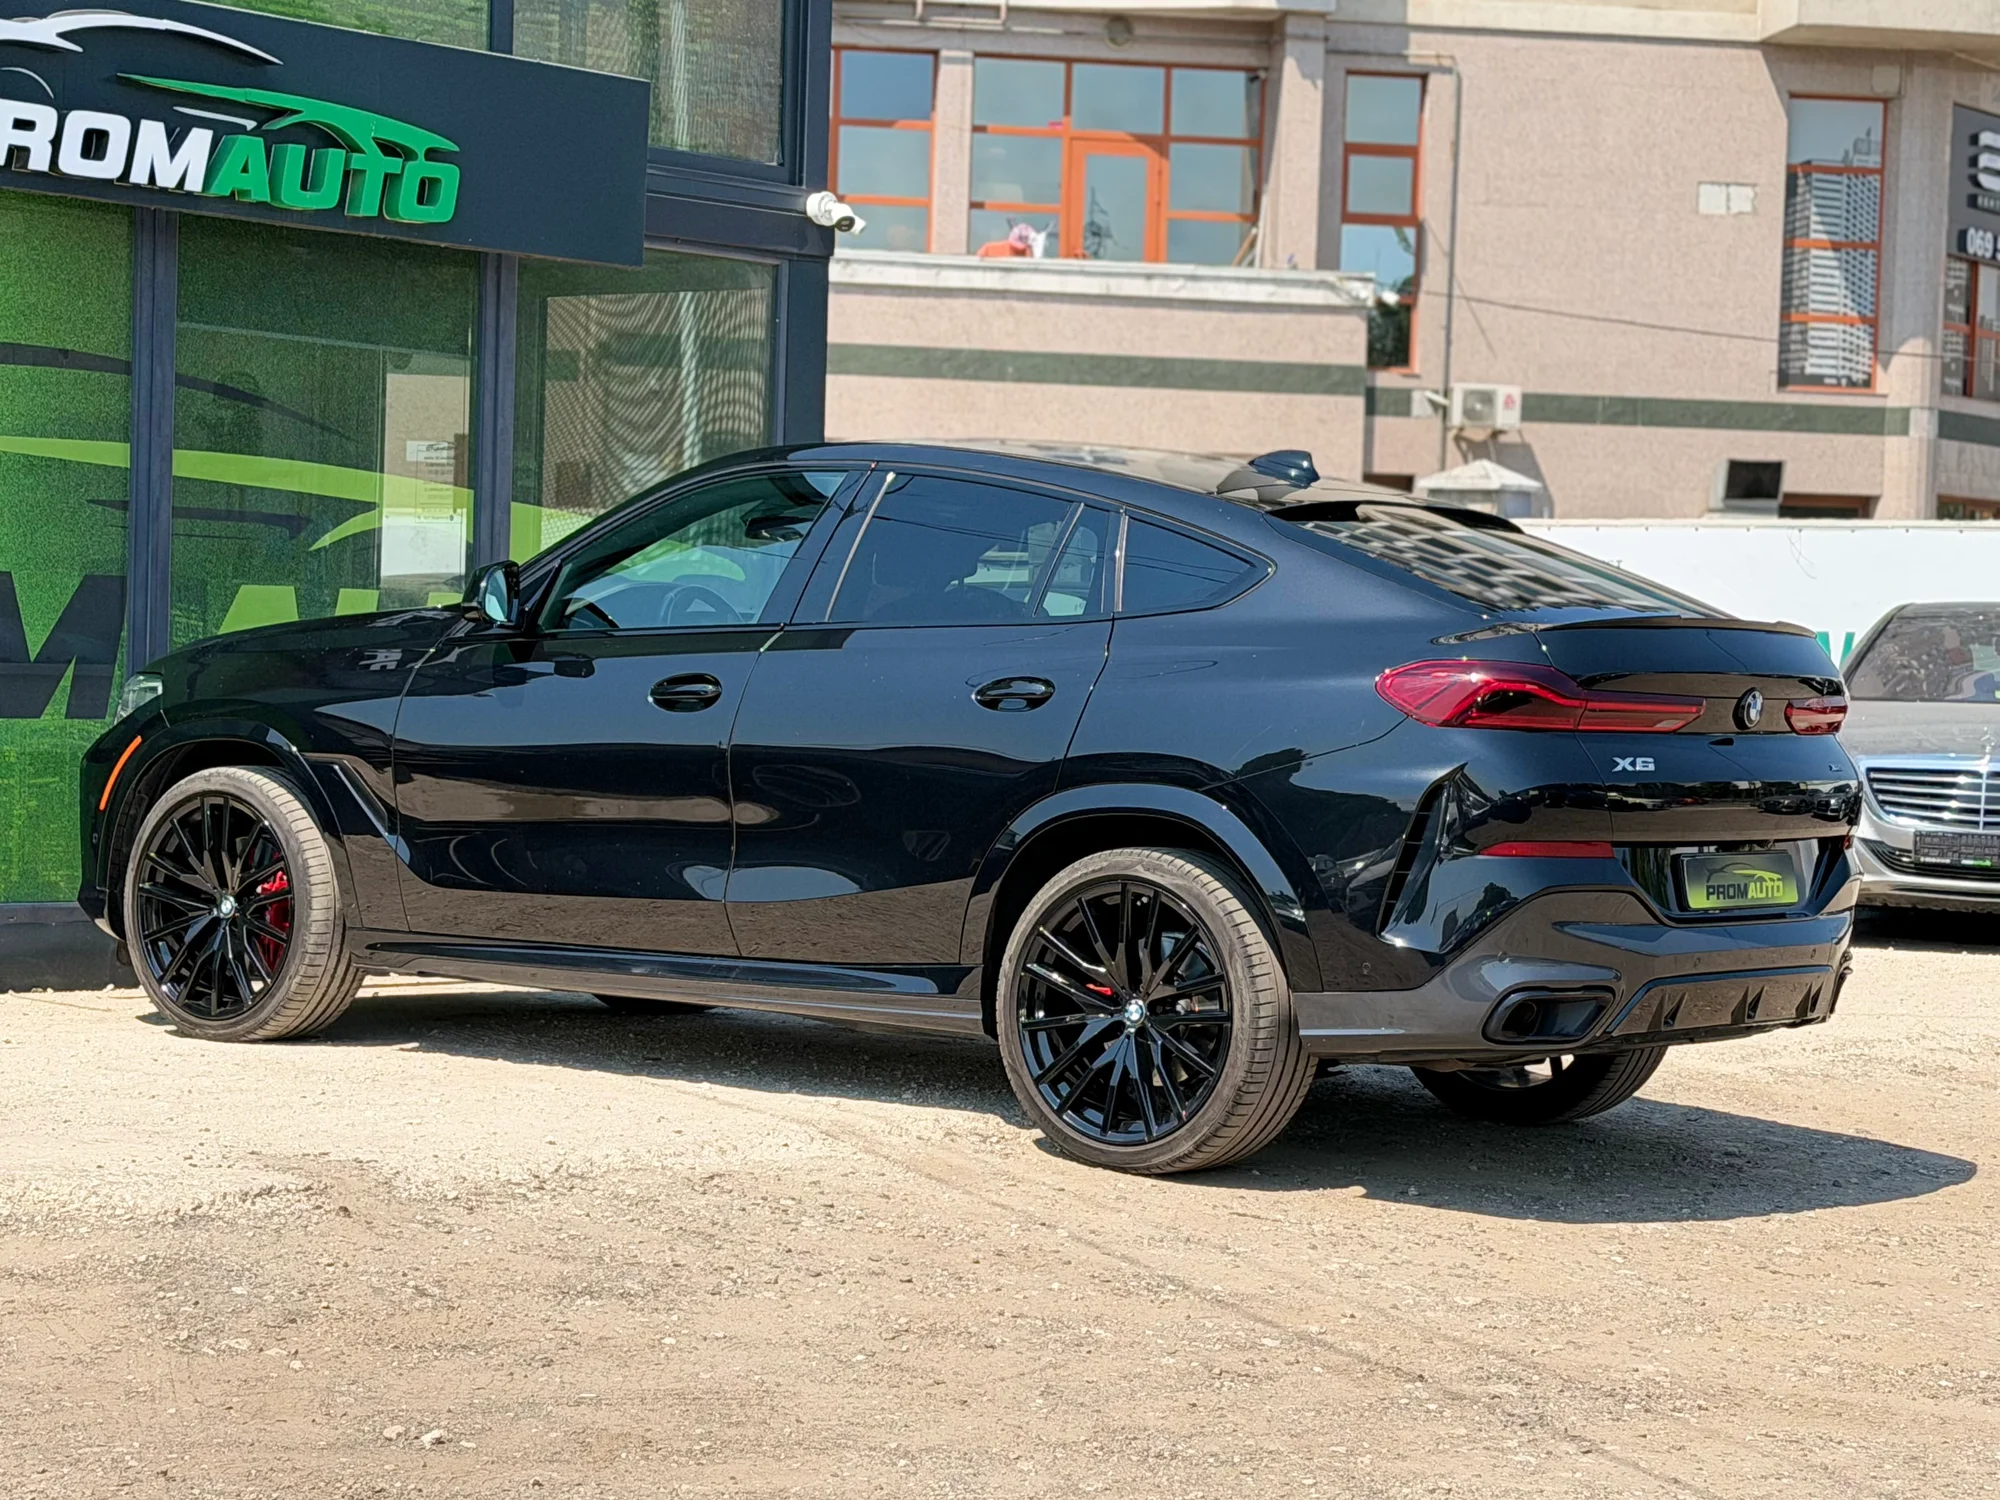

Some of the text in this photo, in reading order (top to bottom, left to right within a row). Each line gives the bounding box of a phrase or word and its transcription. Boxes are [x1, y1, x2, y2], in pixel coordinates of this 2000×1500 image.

[1966, 226, 1994, 260] 069
[1612, 756, 1656, 773] X6
[1705, 880, 1784, 901] PROMAUTO
